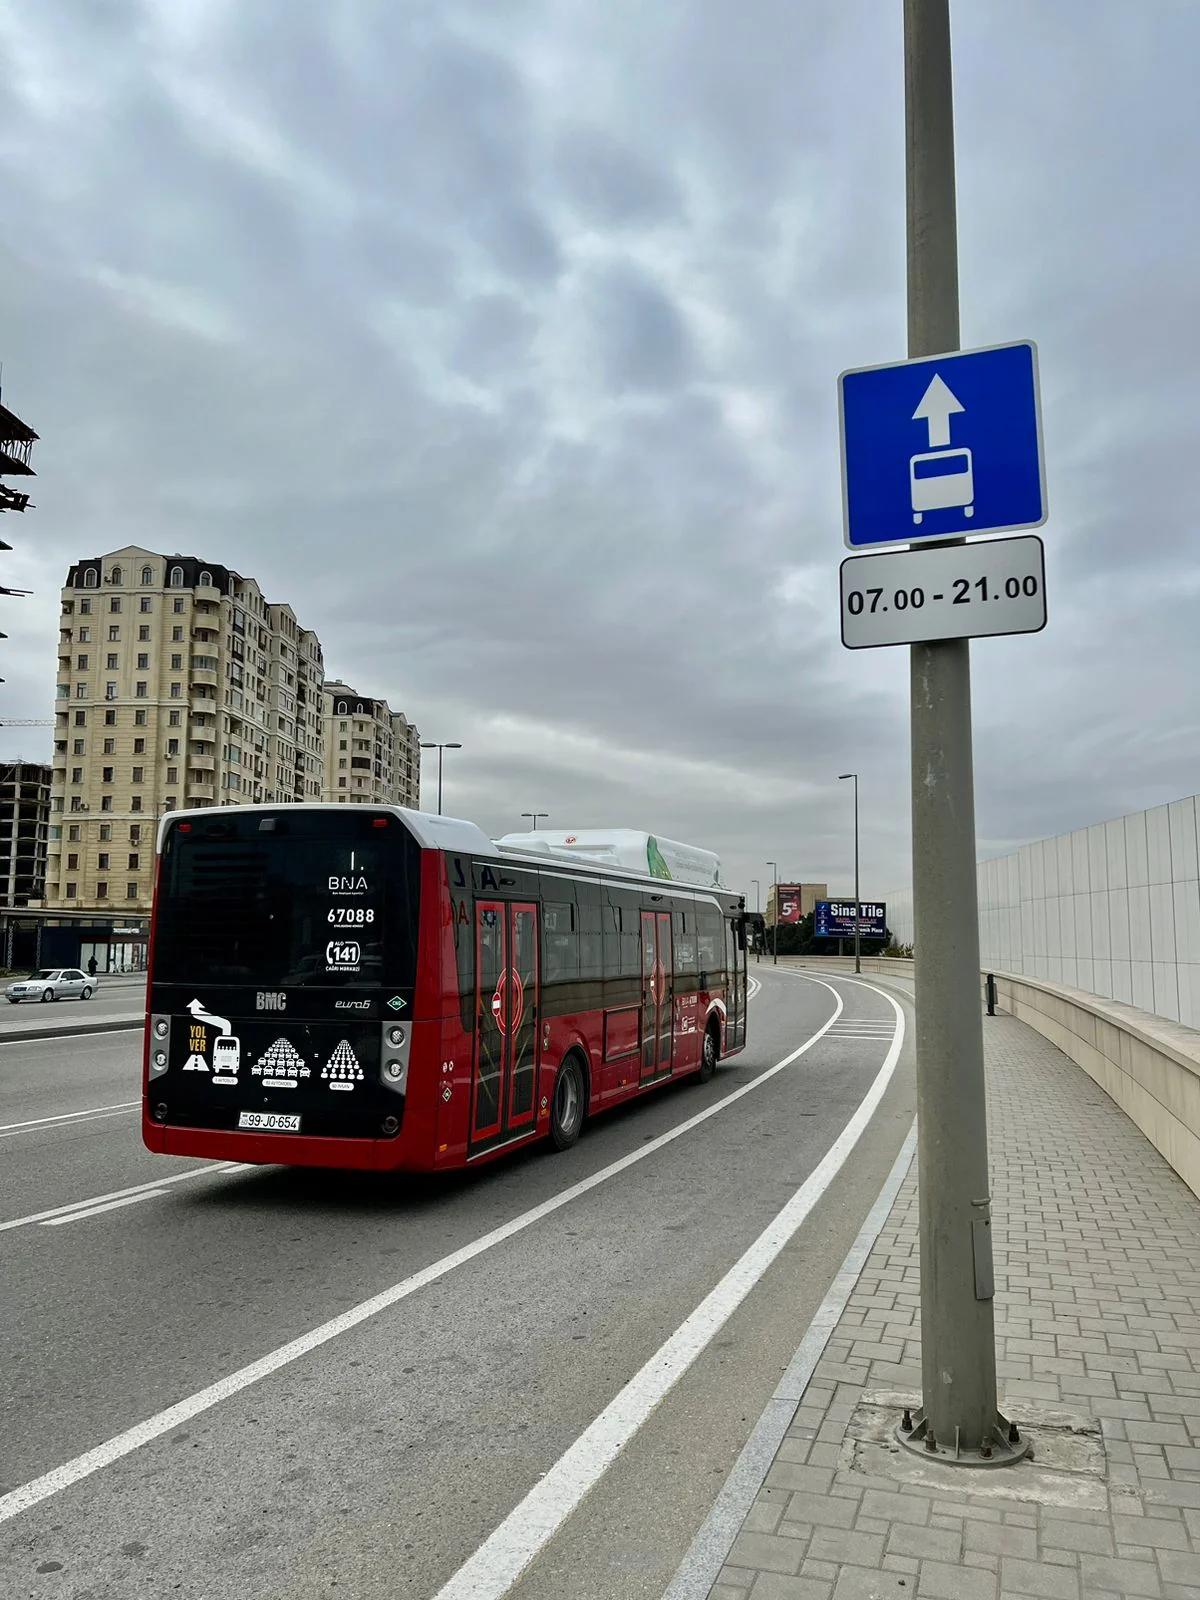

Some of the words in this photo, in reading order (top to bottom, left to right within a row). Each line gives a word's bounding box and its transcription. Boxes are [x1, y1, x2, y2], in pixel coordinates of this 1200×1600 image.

[847, 588, 925, 615] 07.00
[952, 576, 1038, 604] 21.00
[328, 876, 368, 890] BNA
[327, 908, 375, 923] 67088
[830, 903, 856, 917] Sina
[860, 904, 884, 917] Tile
[333, 946, 357, 961] 141
[256, 991, 287, 1011] BMC
[334, 999, 372, 1009] euro6
[189, 1025, 207, 1039] YOL
[189, 1038, 206, 1052] VER
